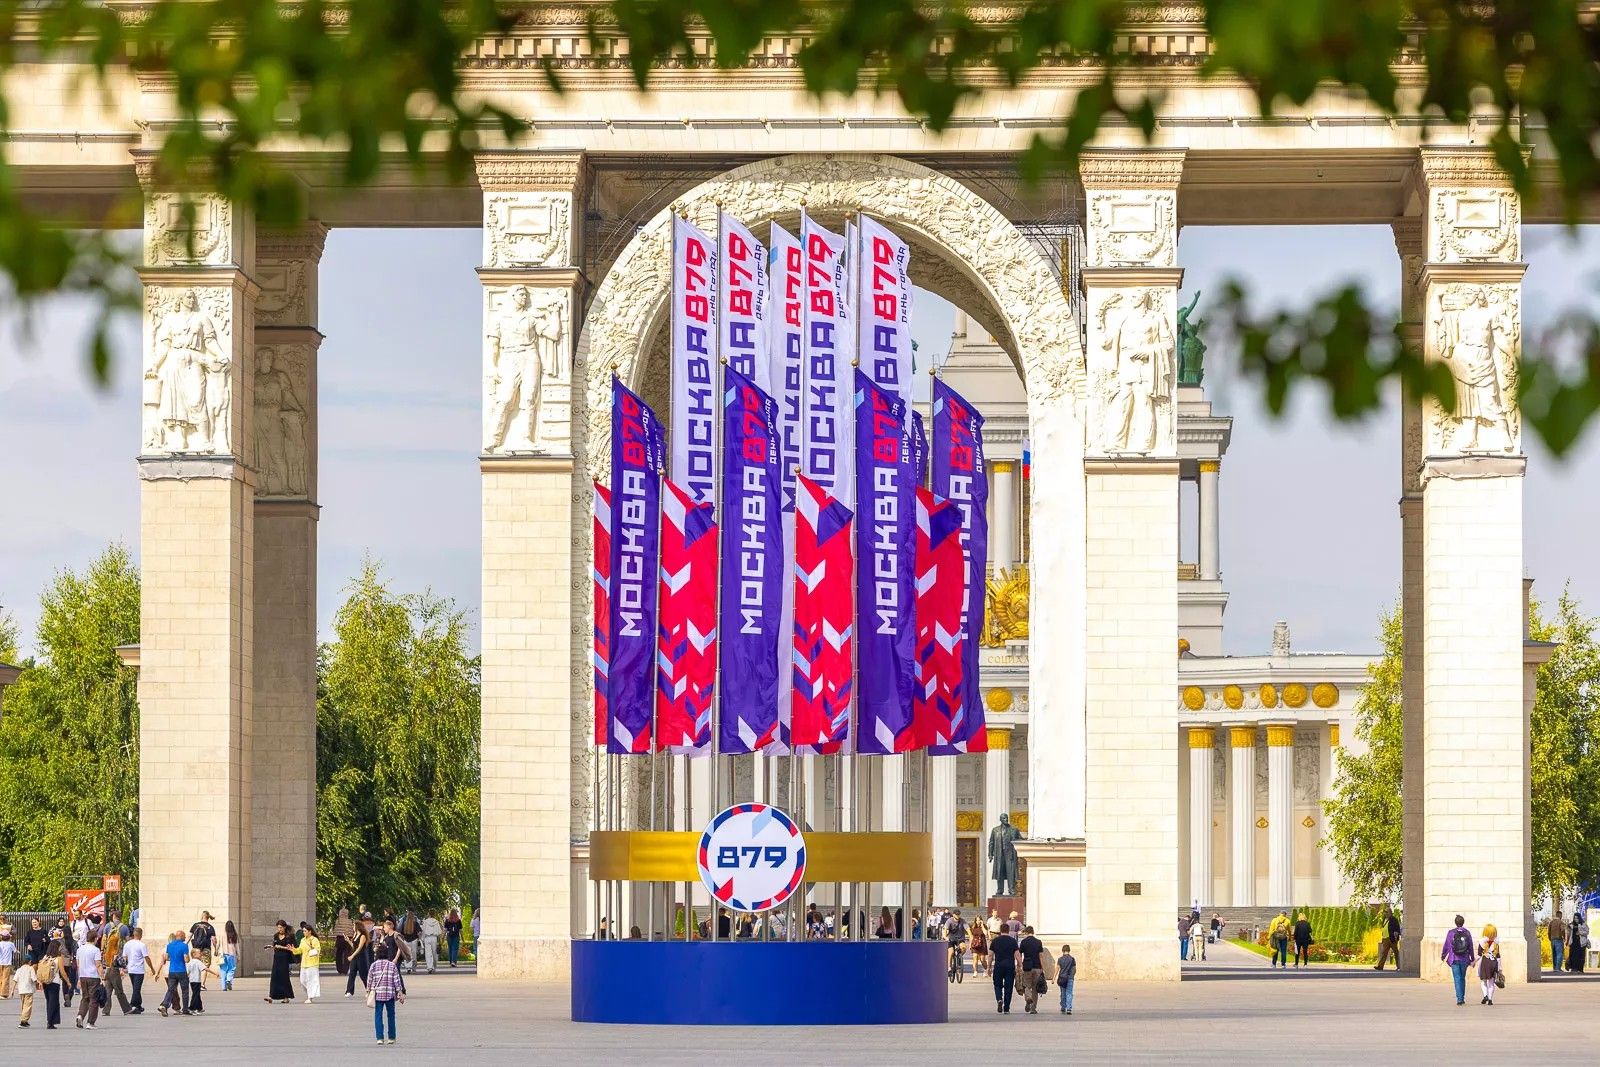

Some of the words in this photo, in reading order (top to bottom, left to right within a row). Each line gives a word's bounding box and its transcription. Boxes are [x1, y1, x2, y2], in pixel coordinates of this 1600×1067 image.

[686, 237, 708, 322] 879
[729, 233, 753, 316] 879
[755, 289, 764, 321] ДЕНЬ
[808, 234, 834, 317] 879
[873, 237, 896, 321] 879
[901, 434, 910, 464] ДЕНЬ
[619, 470, 646, 637] МОСКВА
[740, 465, 766, 635] МОСКВА
[874, 466, 898, 635] МОСКВА
[717, 846, 787, 868] 879
